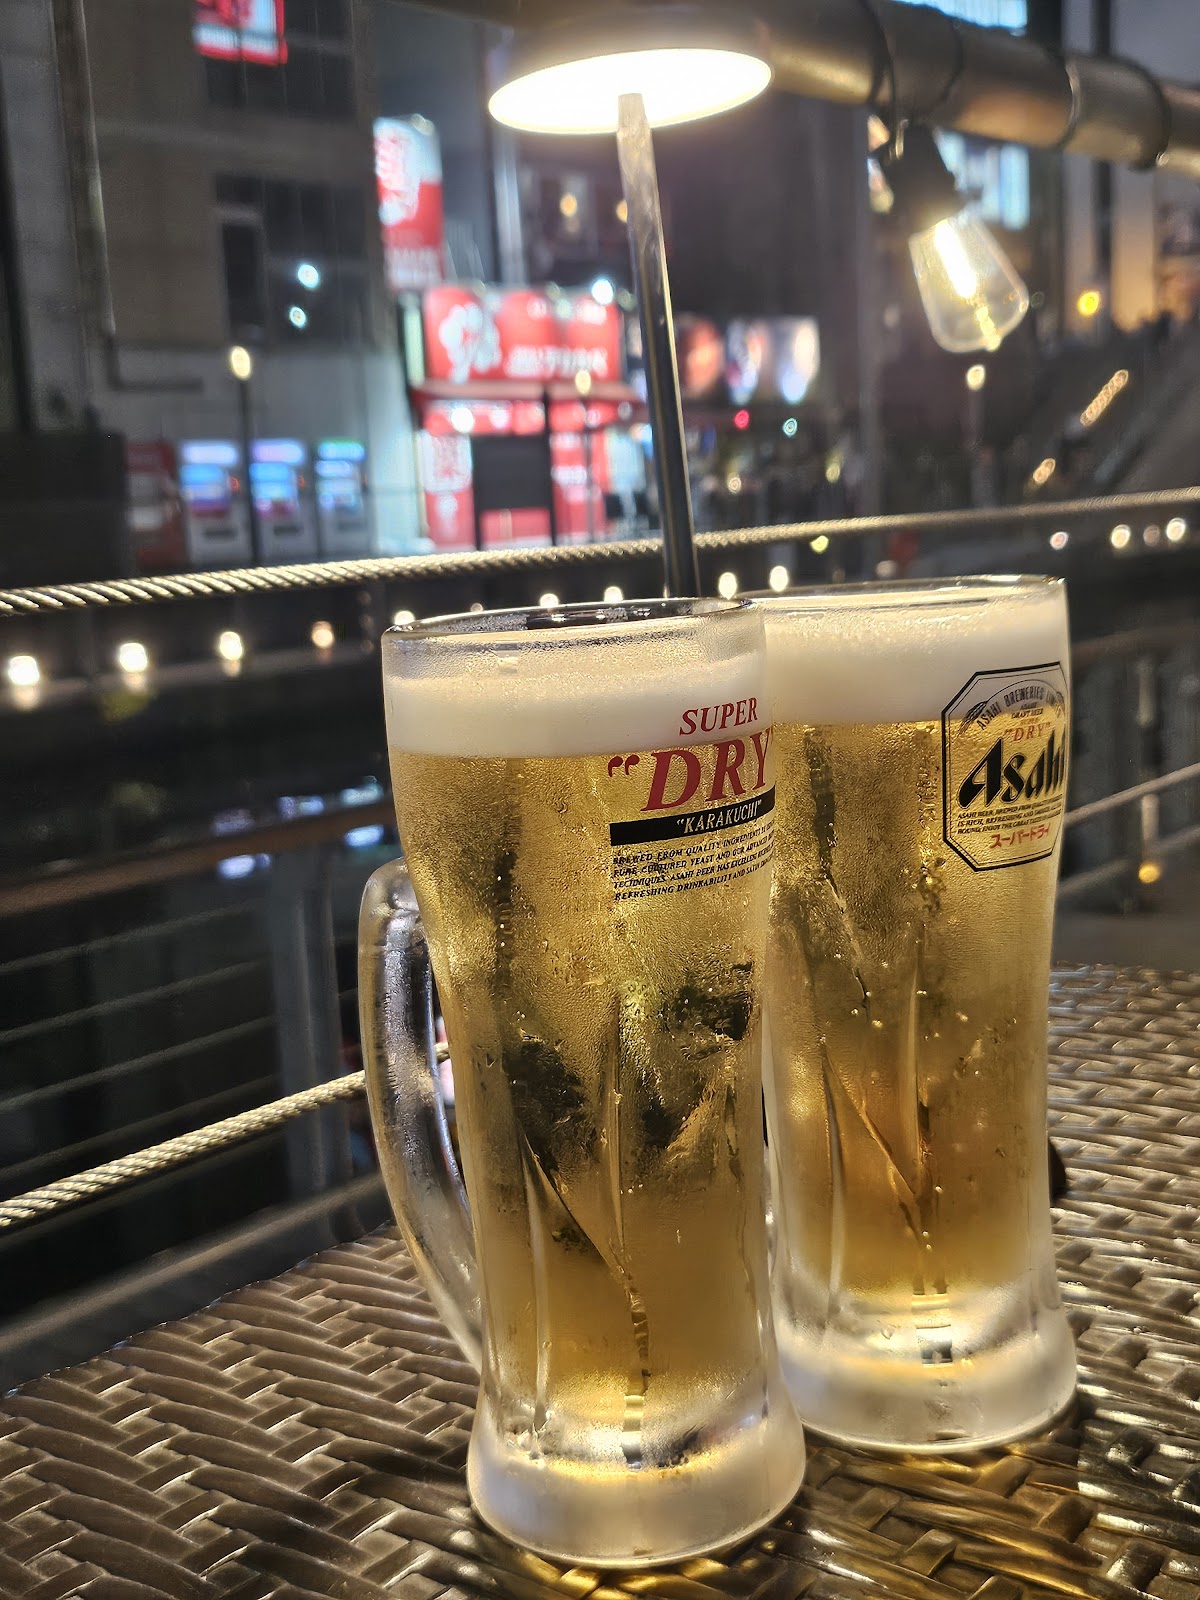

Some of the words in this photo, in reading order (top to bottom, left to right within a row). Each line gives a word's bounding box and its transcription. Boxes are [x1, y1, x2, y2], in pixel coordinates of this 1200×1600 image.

[679, 697, 758, 736] SUPER
[976, 701, 1002, 731] ASAHI
[1003, 686, 1045, 707] BREWERIES
[956, 726, 1067, 810] Asahi
[657, 848, 683, 861] FROM
[690, 855, 715, 867] YEAST
[614, 885, 675, 901] REFRESHING
[676, 873, 732, 892] DRINKABILITY
